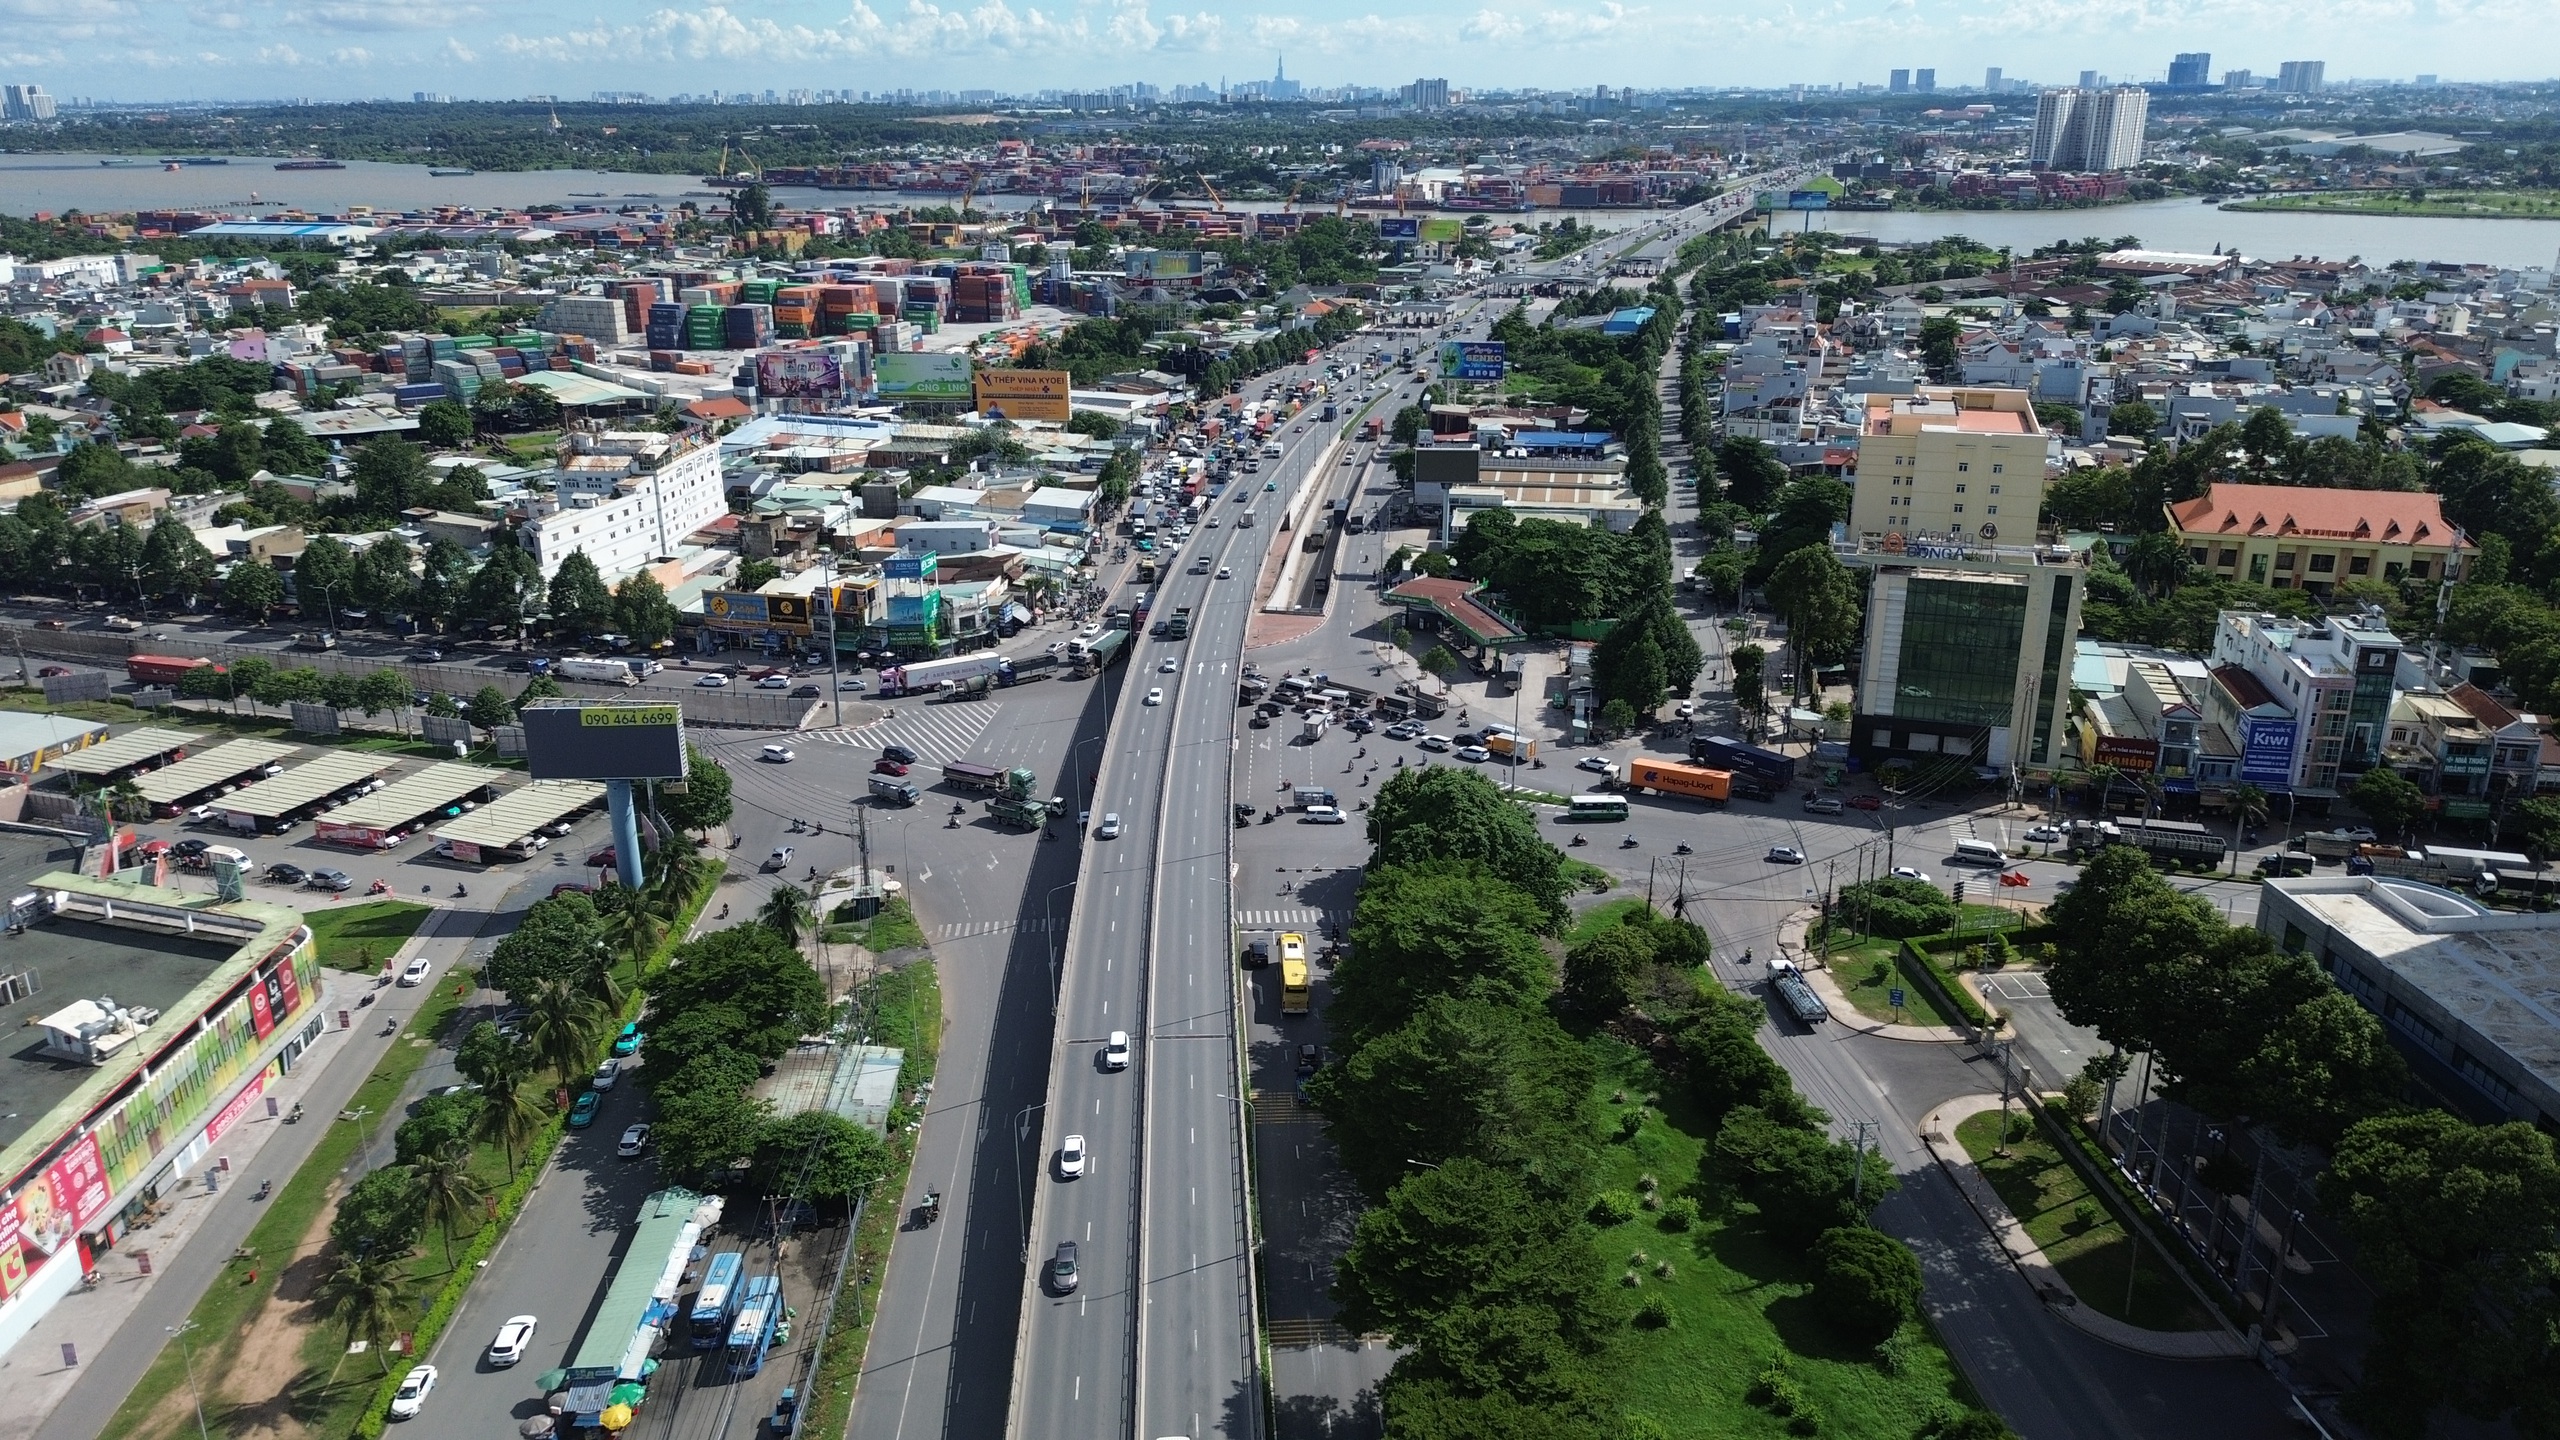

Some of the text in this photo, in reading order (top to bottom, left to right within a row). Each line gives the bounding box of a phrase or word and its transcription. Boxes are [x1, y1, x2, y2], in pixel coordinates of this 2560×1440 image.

[1466, 354, 1502, 362] SENKO
[994, 375, 1016, 384] THÉP
[1039, 377, 1065, 385] KYOEI
[917, 383, 940, 392] CNG
[948, 384, 968, 392] LNG
[585, 713, 673, 725] 090 464 6699
[2455, 756, 2467, 764] NHÀ
[1662, 775, 1714, 791] Hapag-Lloyd
[1, 1206, 17, 1225] chợ
[0, 1219, 20, 1241] nline
